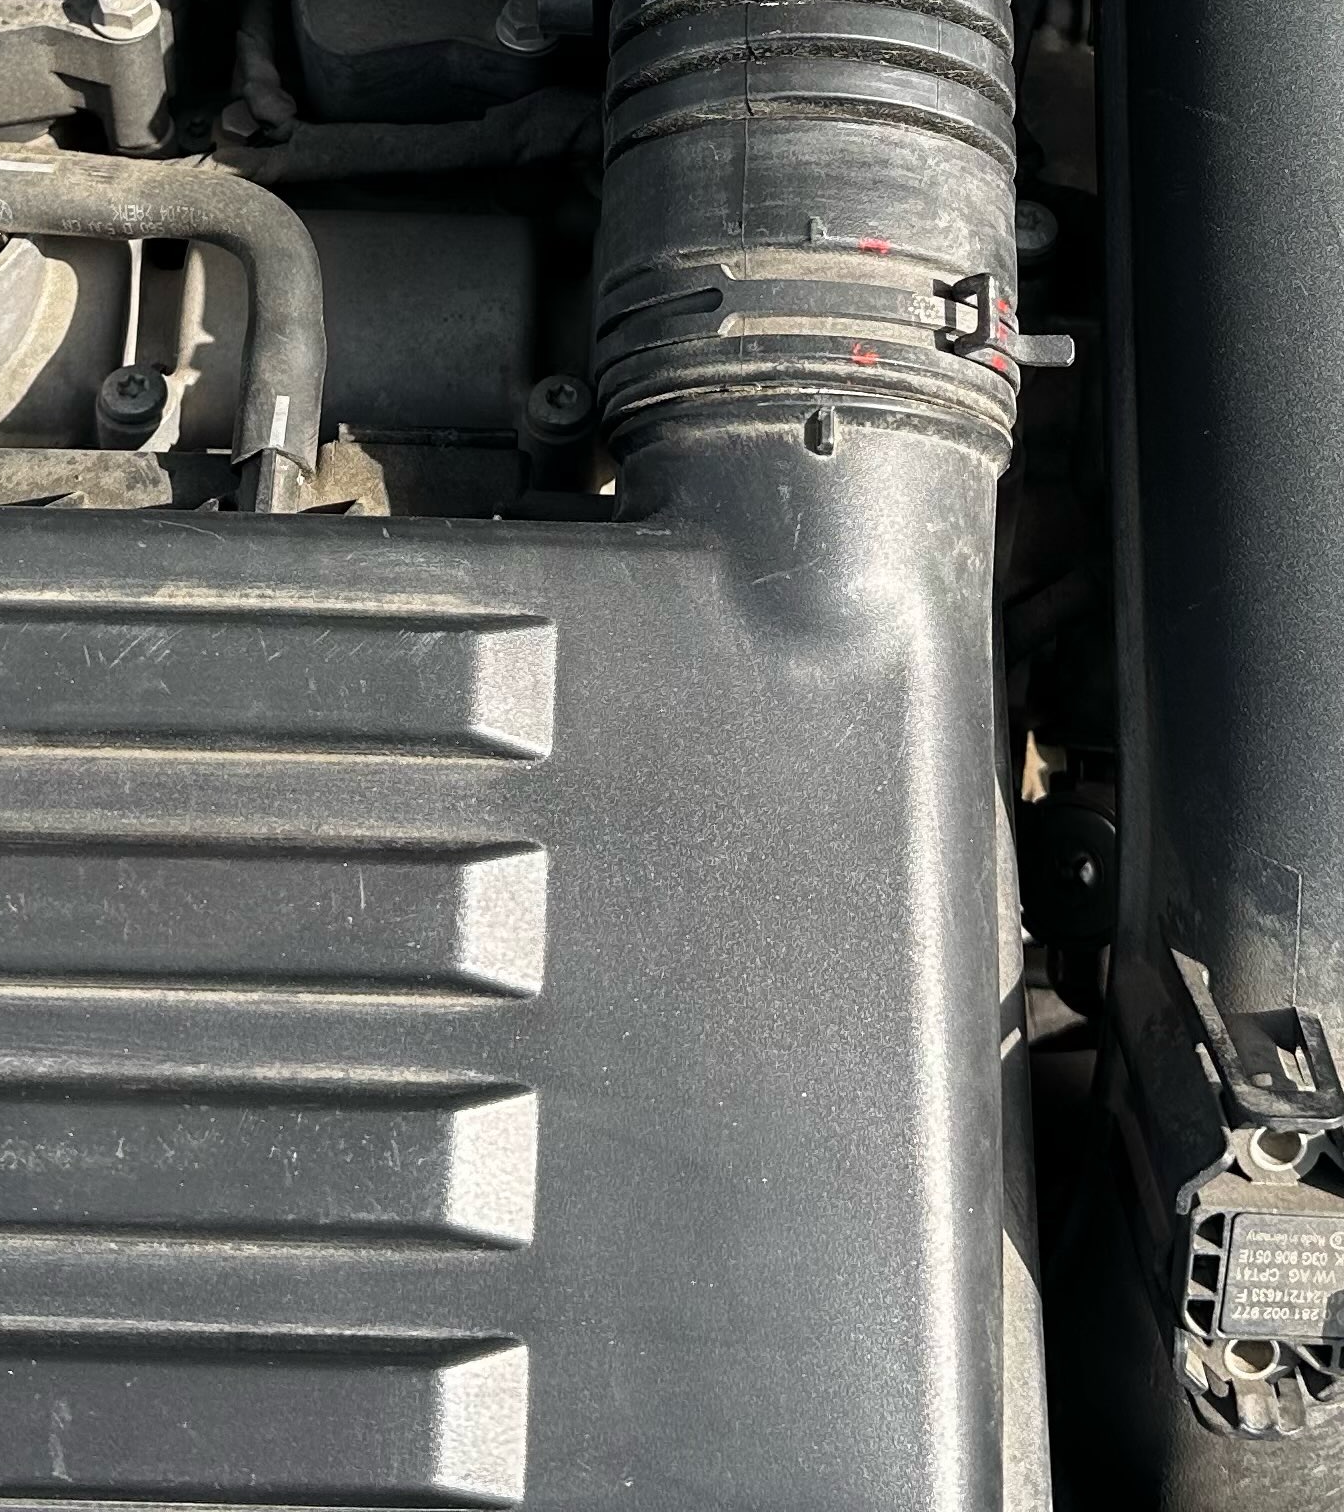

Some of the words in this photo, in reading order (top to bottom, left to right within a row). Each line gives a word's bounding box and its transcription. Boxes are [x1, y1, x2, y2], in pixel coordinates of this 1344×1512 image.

[1246, 1229, 1288, 1245] Germany
[1302, 1234, 1326, 1246] Made
[1238, 1248, 1272, 1264] 051E
[1301, 1251, 1329, 1266] 03G
[1288, 1269, 1311, 1283] AG
[1312, 1270, 1337, 1284] VW
[1235, 1288, 1248, 1303] F
[1262, 1307, 1290, 1320] 002
[1294, 1307, 1320, 1321] 281
